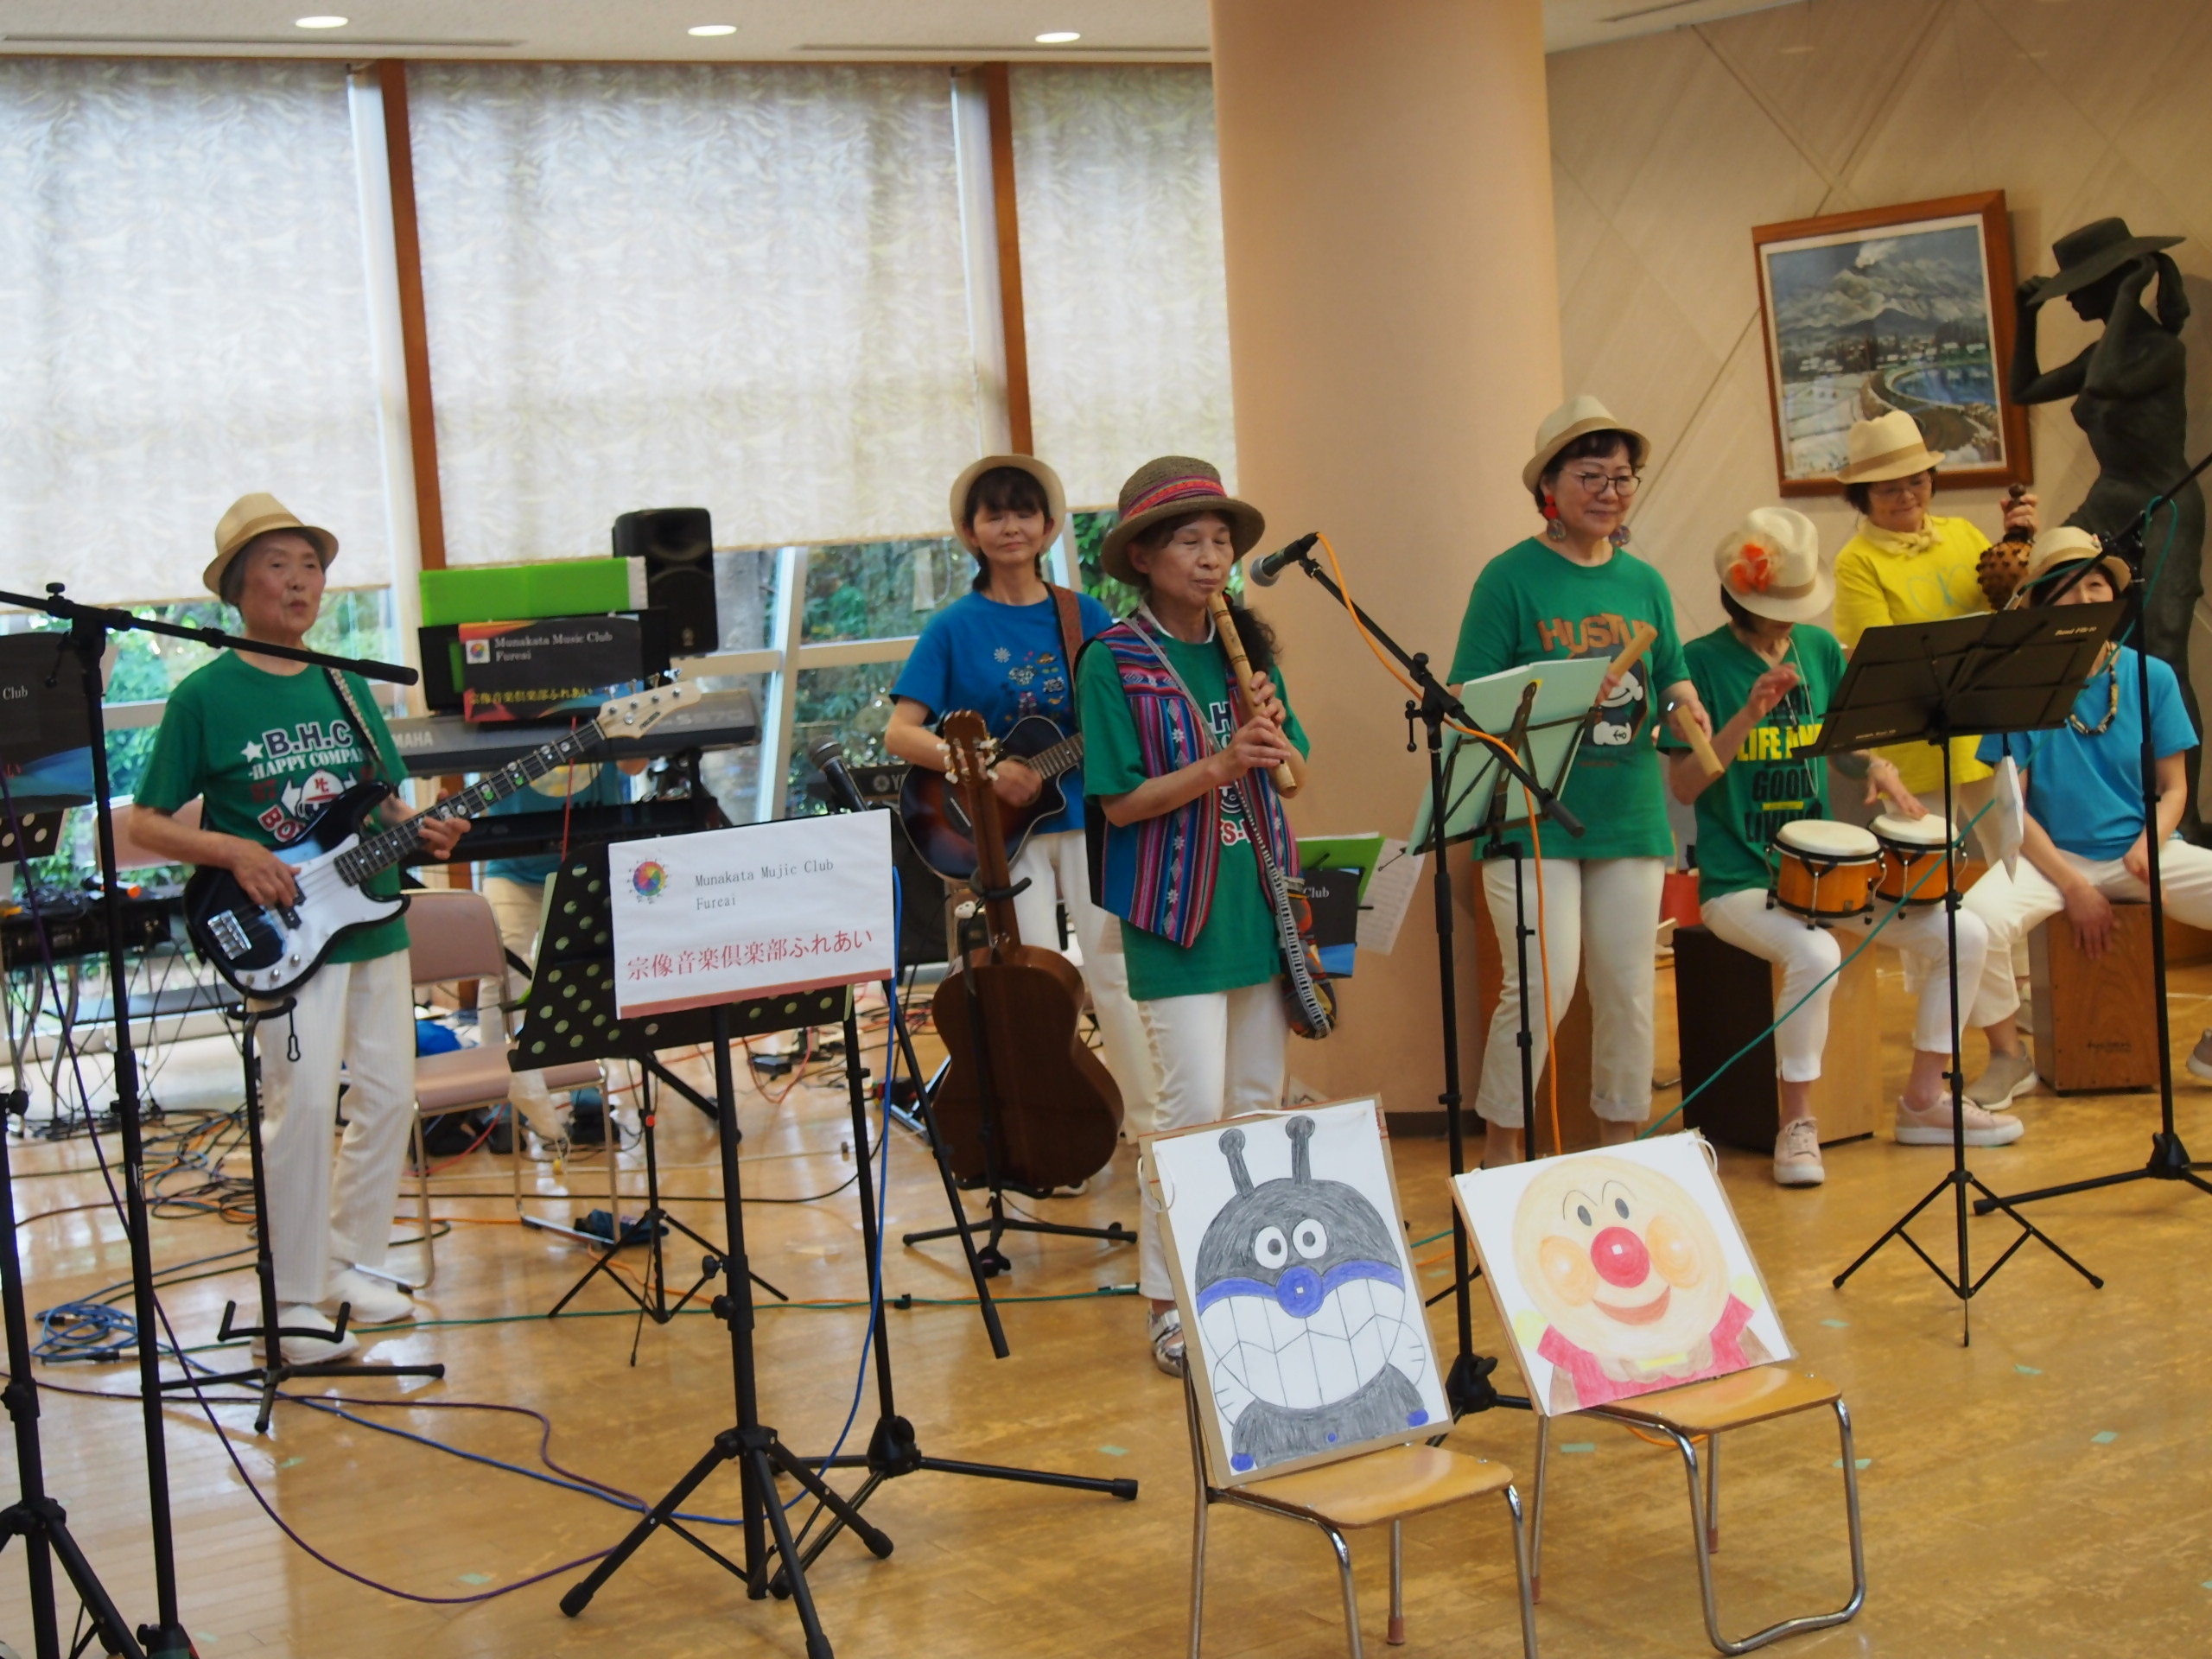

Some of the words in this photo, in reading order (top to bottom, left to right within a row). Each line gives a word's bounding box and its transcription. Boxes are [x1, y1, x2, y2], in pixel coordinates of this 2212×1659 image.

[586, 632, 613, 643] Club
[3, 685, 28, 700] Club
[1737, 727, 1782, 761] LIFE
[1752, 768, 1815, 802] GOOD
[695, 868, 754, 887] Munakata
[761, 864, 798, 880] Mujic
[804, 860, 834, 874] Club
[696, 895, 736, 910] Fureai
[1303, 887, 1330, 899] Club
[627, 930, 873, 981] 宗像音楽倶楽部ふれあい
